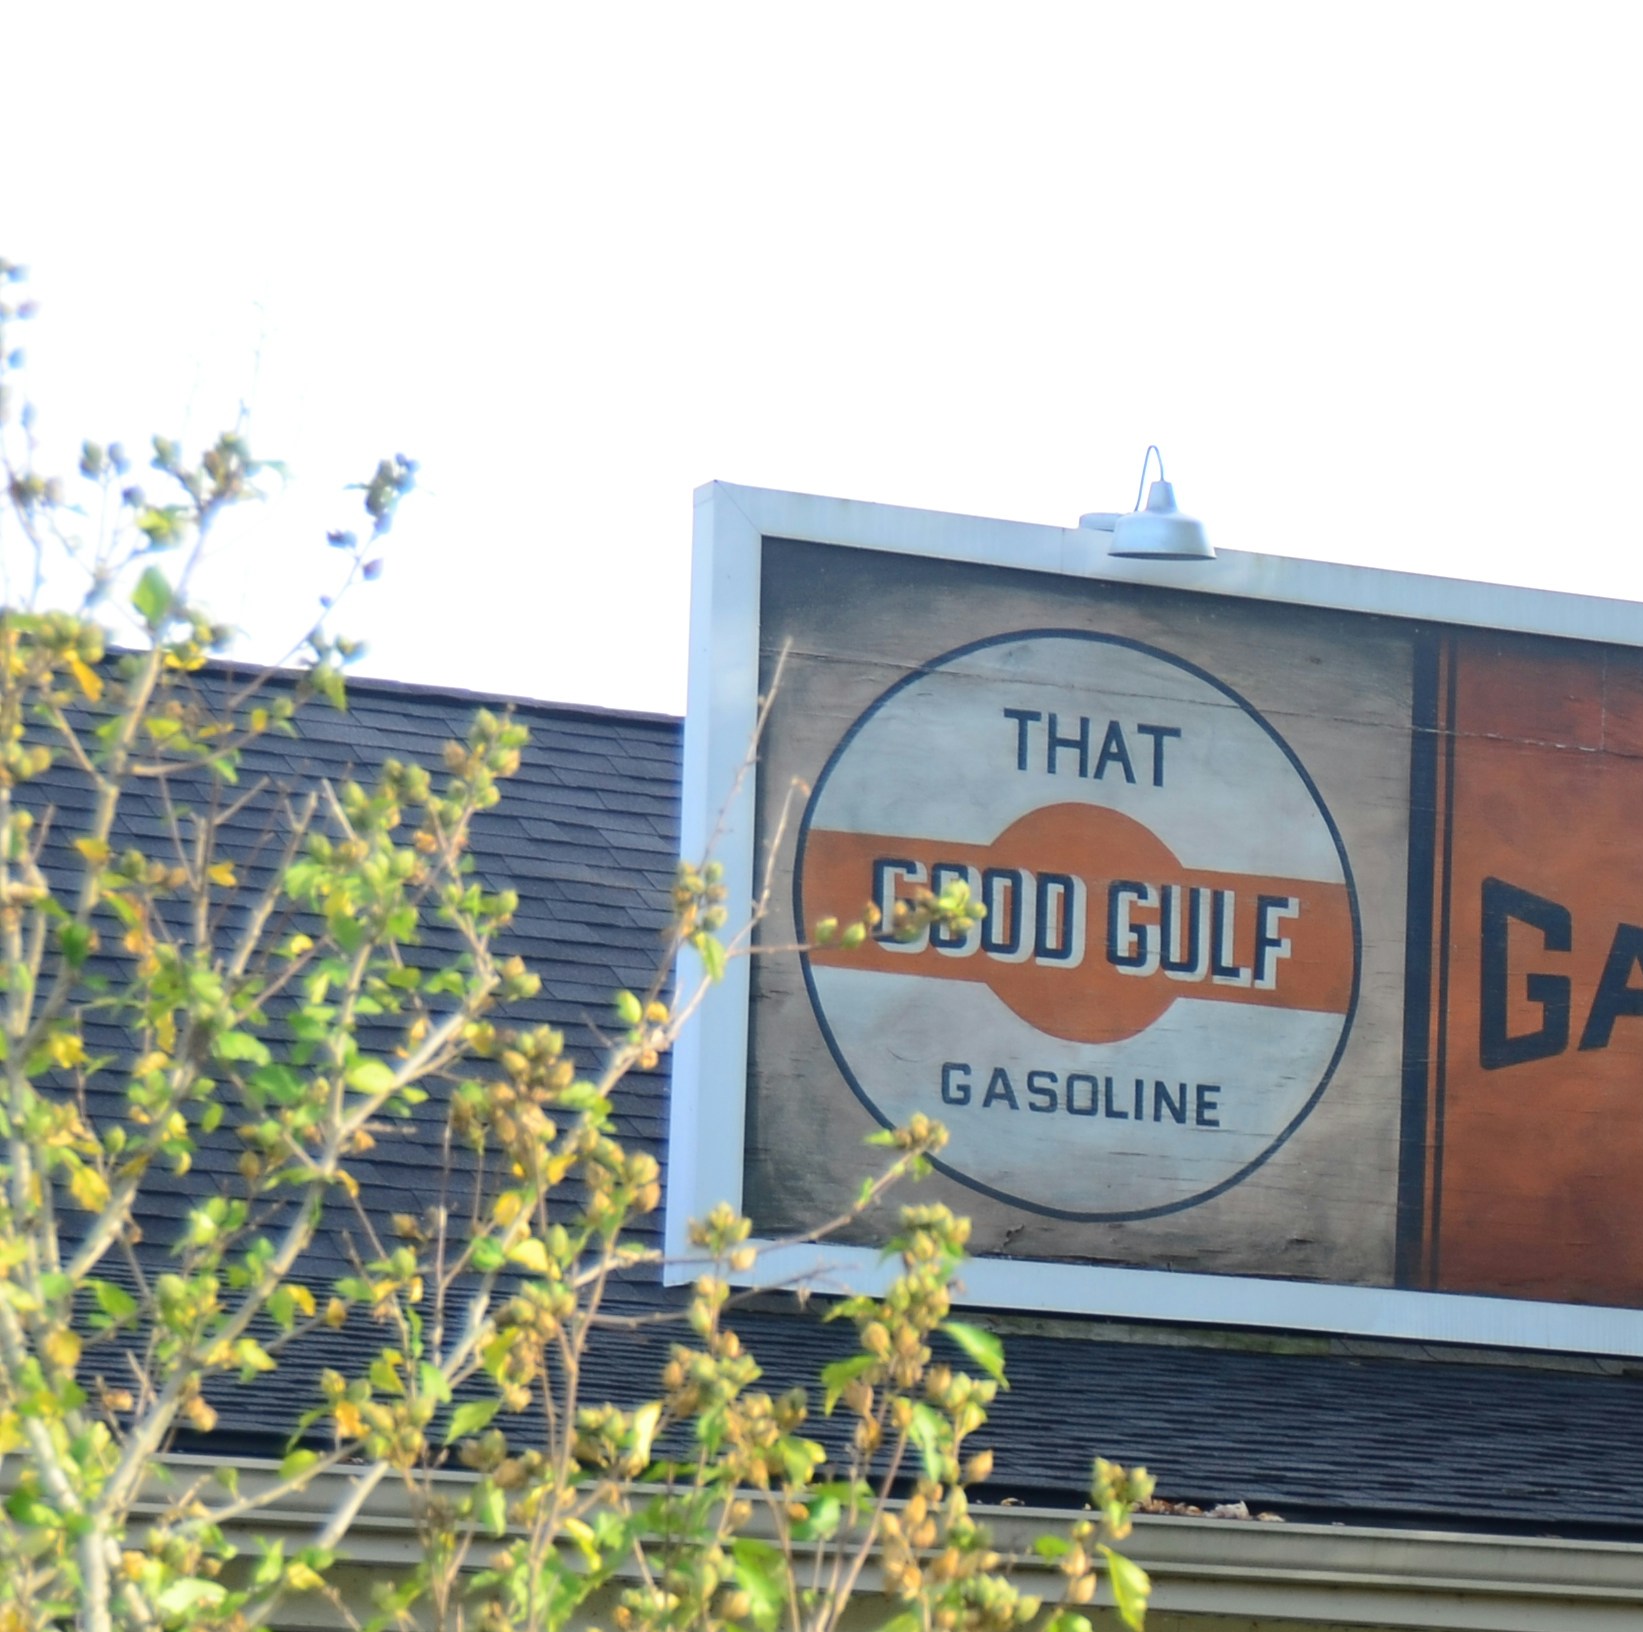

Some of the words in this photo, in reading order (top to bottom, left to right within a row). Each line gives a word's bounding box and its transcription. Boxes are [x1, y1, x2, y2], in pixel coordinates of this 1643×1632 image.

[1004, 708, 1181, 788] THAT
[872, 857, 1087, 969] GOOD
[1106, 879, 1299, 990] GULF
[941, 1061, 1221, 1128] GASOLINE
